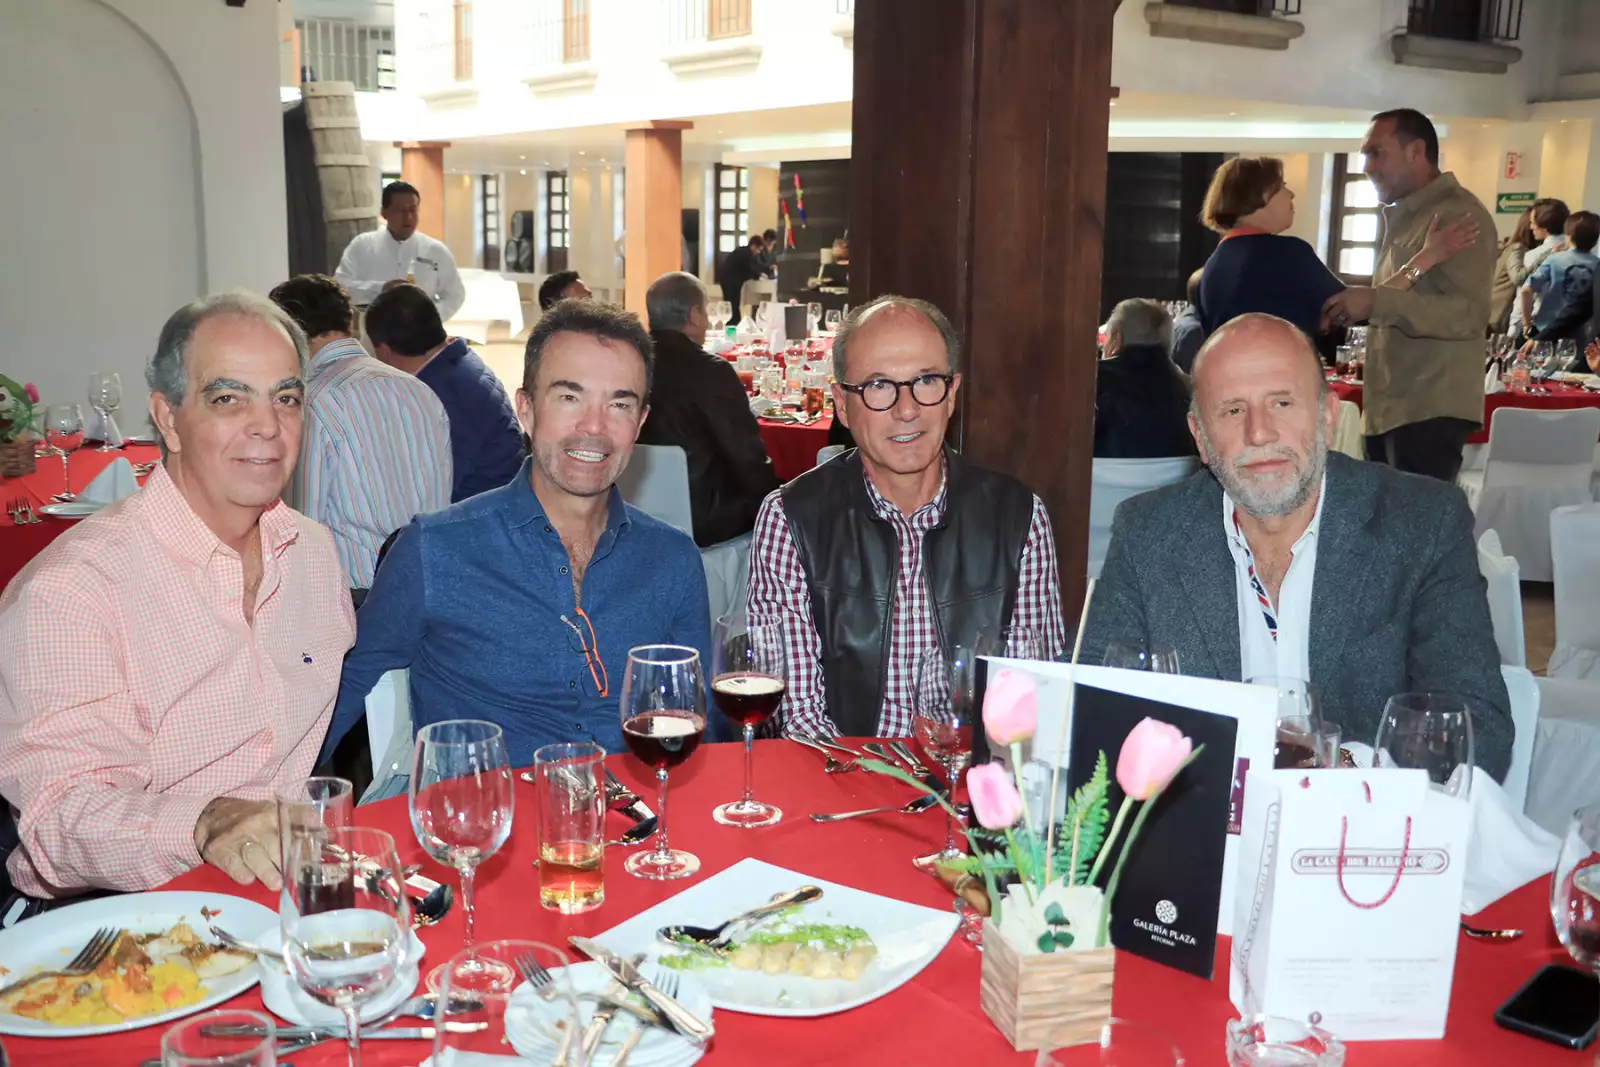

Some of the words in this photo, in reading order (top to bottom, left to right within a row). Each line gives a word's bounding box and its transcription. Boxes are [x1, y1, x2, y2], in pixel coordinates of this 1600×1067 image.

[1315, 856, 1344, 867] CAS
[1133, 918, 1168, 937] GALERÍA
[1169, 929, 1197, 946] PLAZA
[1151, 934, 1176, 948] REFORMA
